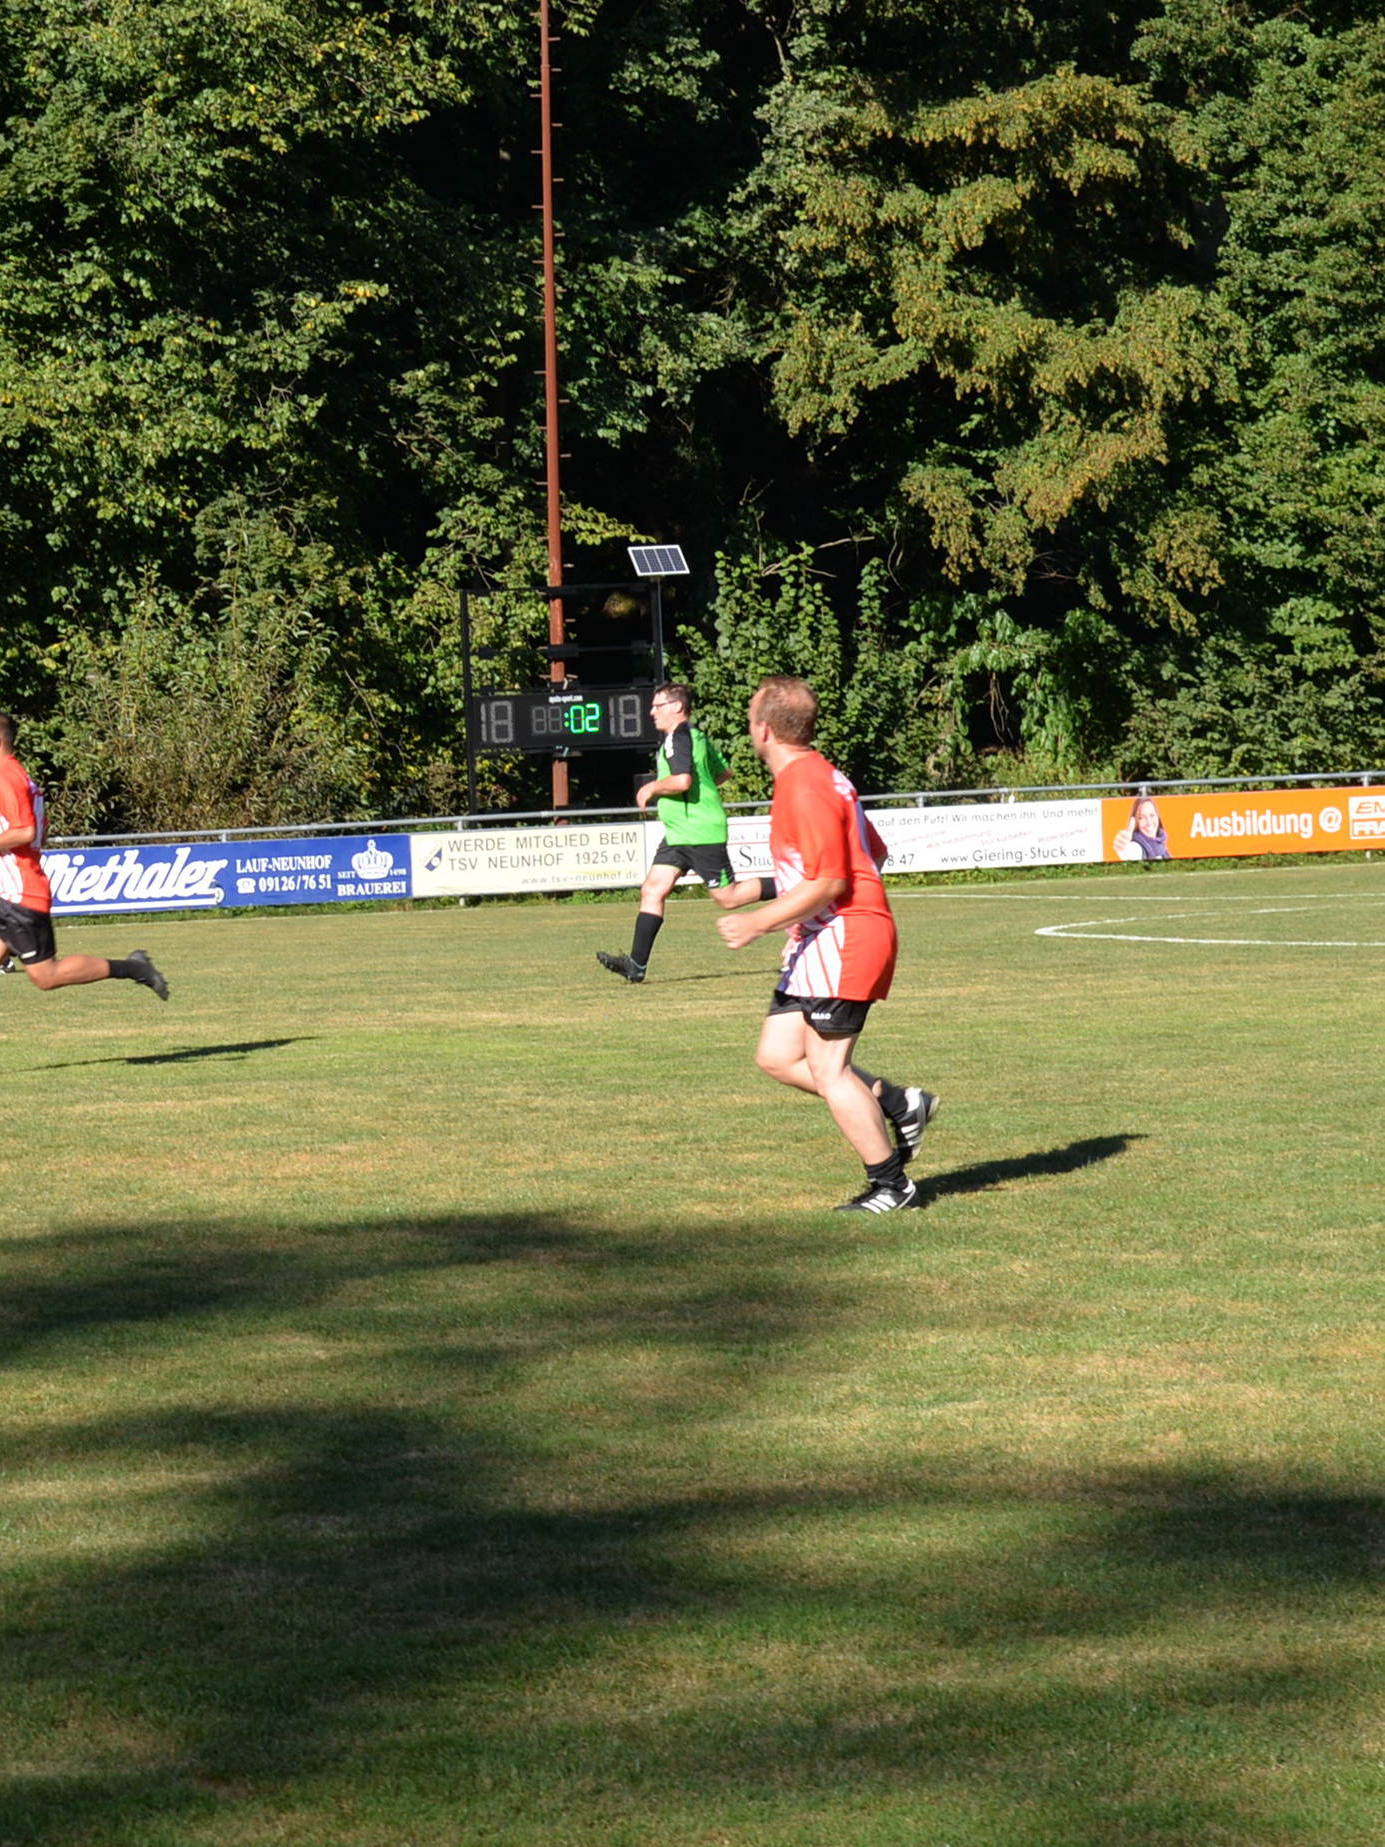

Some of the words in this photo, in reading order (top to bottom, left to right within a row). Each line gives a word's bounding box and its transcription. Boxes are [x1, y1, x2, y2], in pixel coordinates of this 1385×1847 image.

[878, 816, 894, 827] auf
[899, 816, 920, 826] den
[924, 814, 949, 824] Putz!
[952, 813, 967, 823] Wir
[972, 811, 1017, 822] machen
[1043, 809, 1063, 819] Und
[1068, 806, 1098, 817] mehr!
[1190, 809, 1313, 839] Ausbildung
[1319, 806, 1342, 833] @
[448, 837, 506, 852] WERDE
[516, 833, 589, 849] MITGLIED
[599, 831, 637, 845] BEIM
[448, 857, 478, 870] TSV
[488, 853, 564, 869] NEUNHOF
[576, 850, 608, 864] 1925
[614, 850, 639, 863] e.V.
[899, 853, 914, 866] 47
[941, 845, 1086, 864] www.Giering-Stuck.de
[236, 855, 333, 873] LAUF-NEUNHOF
[337, 871, 357, 879] SEIT
[521, 871, 638, 885] www.tsv-neunhof.de
[337, 881, 406, 897] BRAUEREI
